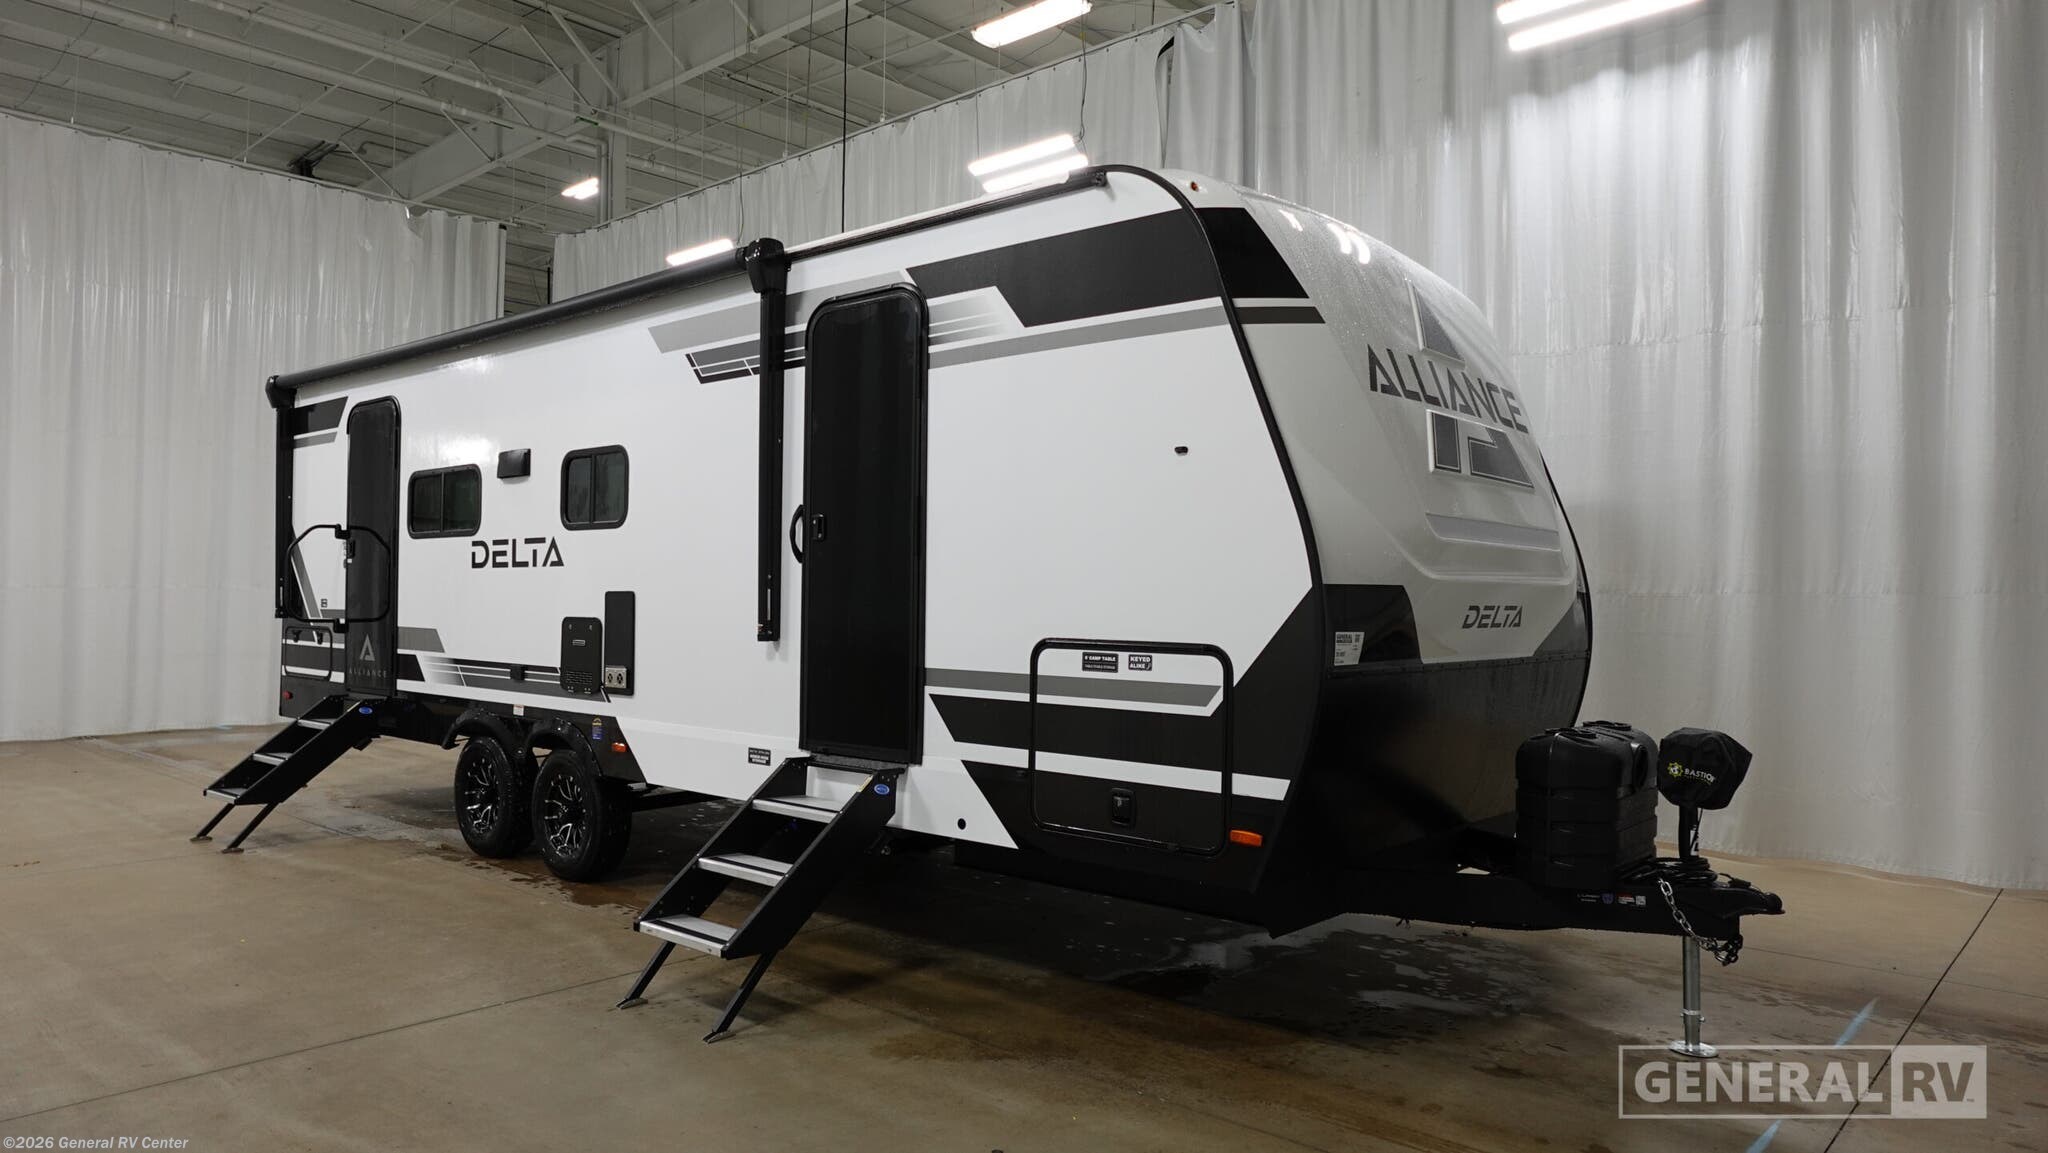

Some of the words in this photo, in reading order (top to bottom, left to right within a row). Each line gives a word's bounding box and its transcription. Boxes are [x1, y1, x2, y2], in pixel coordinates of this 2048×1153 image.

[1367, 344, 1529, 434] ALLIANCE
[471, 537, 564, 568] DELTA
[1462, 605, 1523, 629] DELTA
[348, 667, 388, 679] ALLIANCE
